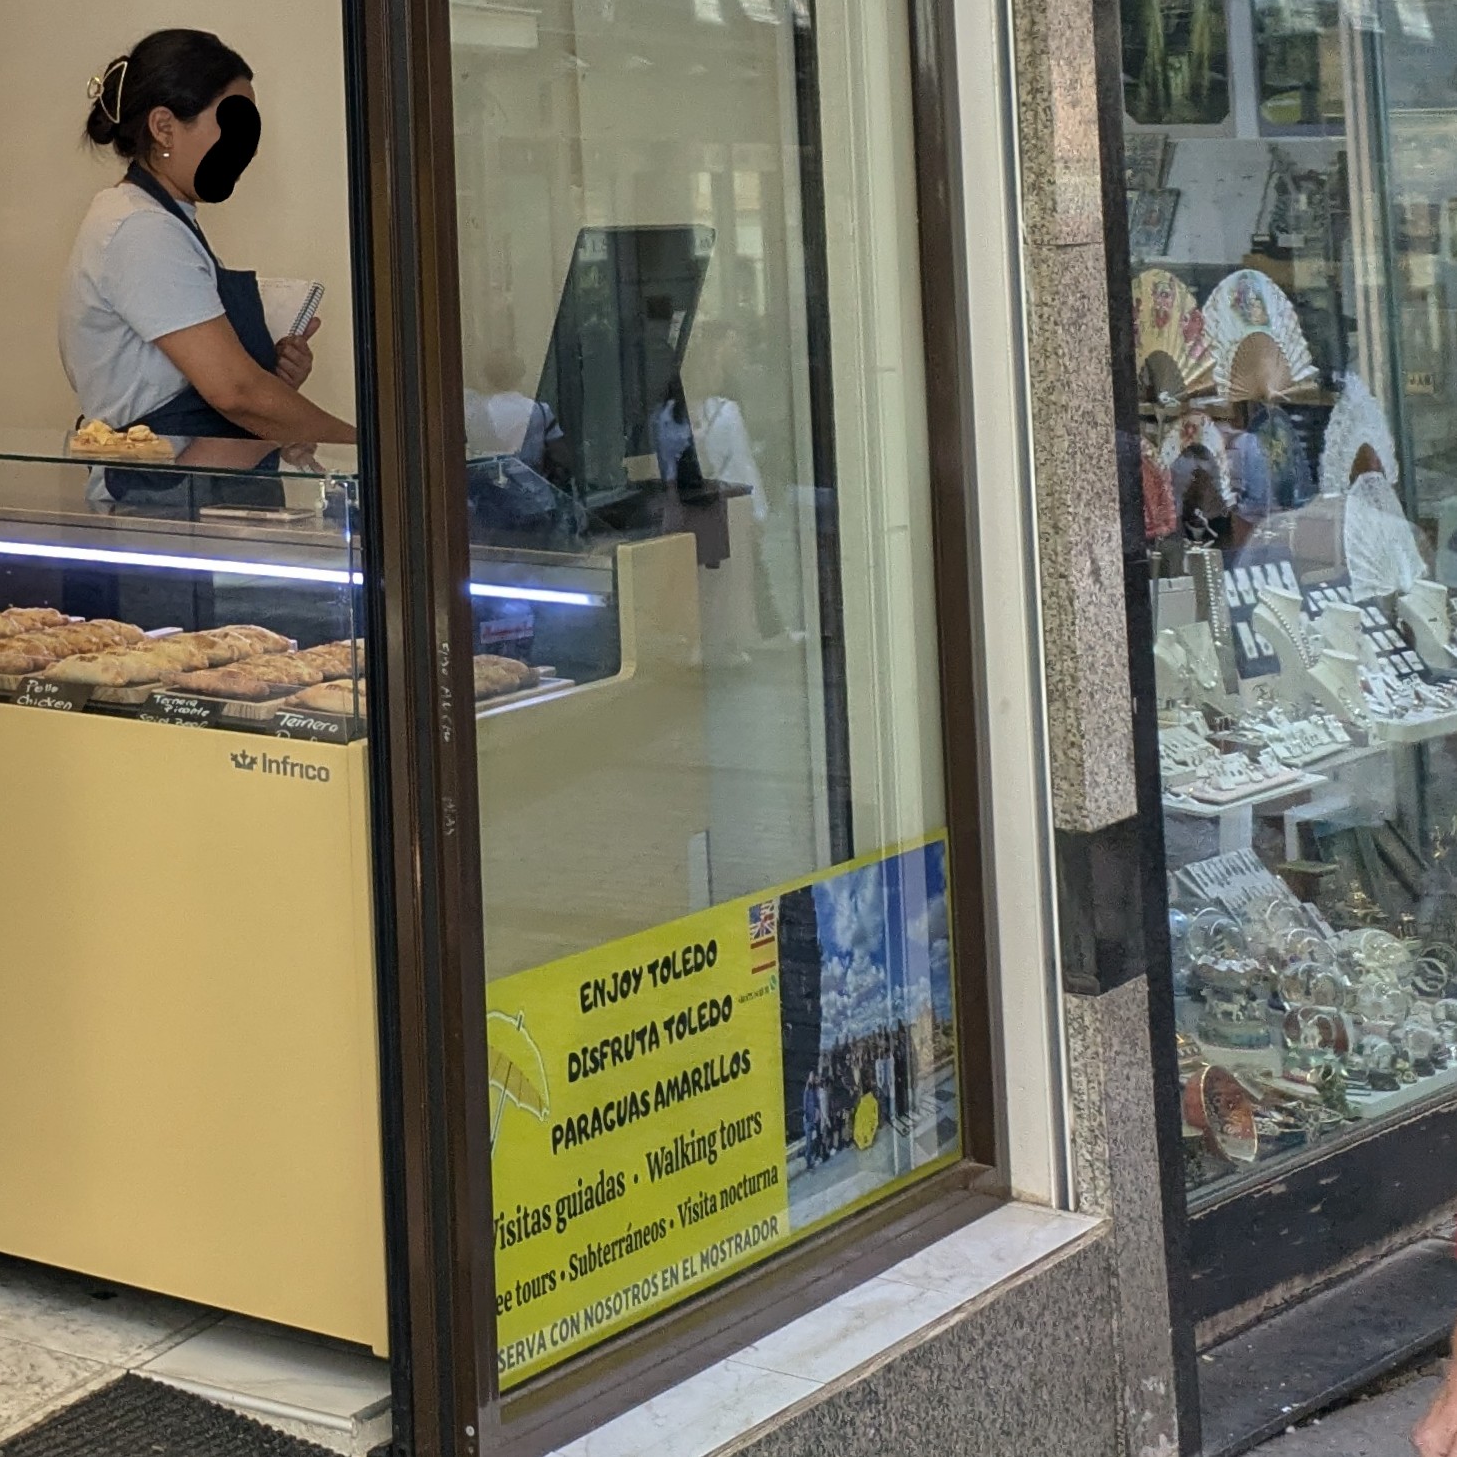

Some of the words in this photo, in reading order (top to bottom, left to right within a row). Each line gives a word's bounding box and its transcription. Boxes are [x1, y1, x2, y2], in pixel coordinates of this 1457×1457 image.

[262, 752, 330, 782] Infrico
[580, 965, 643, 1014] ENJOY
[648, 939, 718, 988] TOLEDO
[568, 1020, 660, 1083] DISFRUTA
[663, 994, 733, 1044] TOLEDO
[551, 1089, 651, 1155] PARAGUAS
[654, 1048, 751, 1112] AMARILLOS
[555, 1169, 626, 1234] guiadas
[645, 1130, 718, 1183] Walking
[720, 1110, 763, 1151] tours
[496, 1293, 513, 1317] ee
[515, 1269, 557, 1308] tours
[569, 1216, 667, 1283] Subterráneos
[677, 1191, 718, 1230] Visita
[720, 1164, 779, 1211] nocturna
[498, 1330, 547, 1373] SERVA
[550, 1310, 581, 1347] CON
[583, 1273, 659, 1333] NOSOTROS
[662, 1264, 679, 1291] EN
[682, 1257, 698, 1281] EL
[700, 1214, 779, 1274] MOSTRADOR
